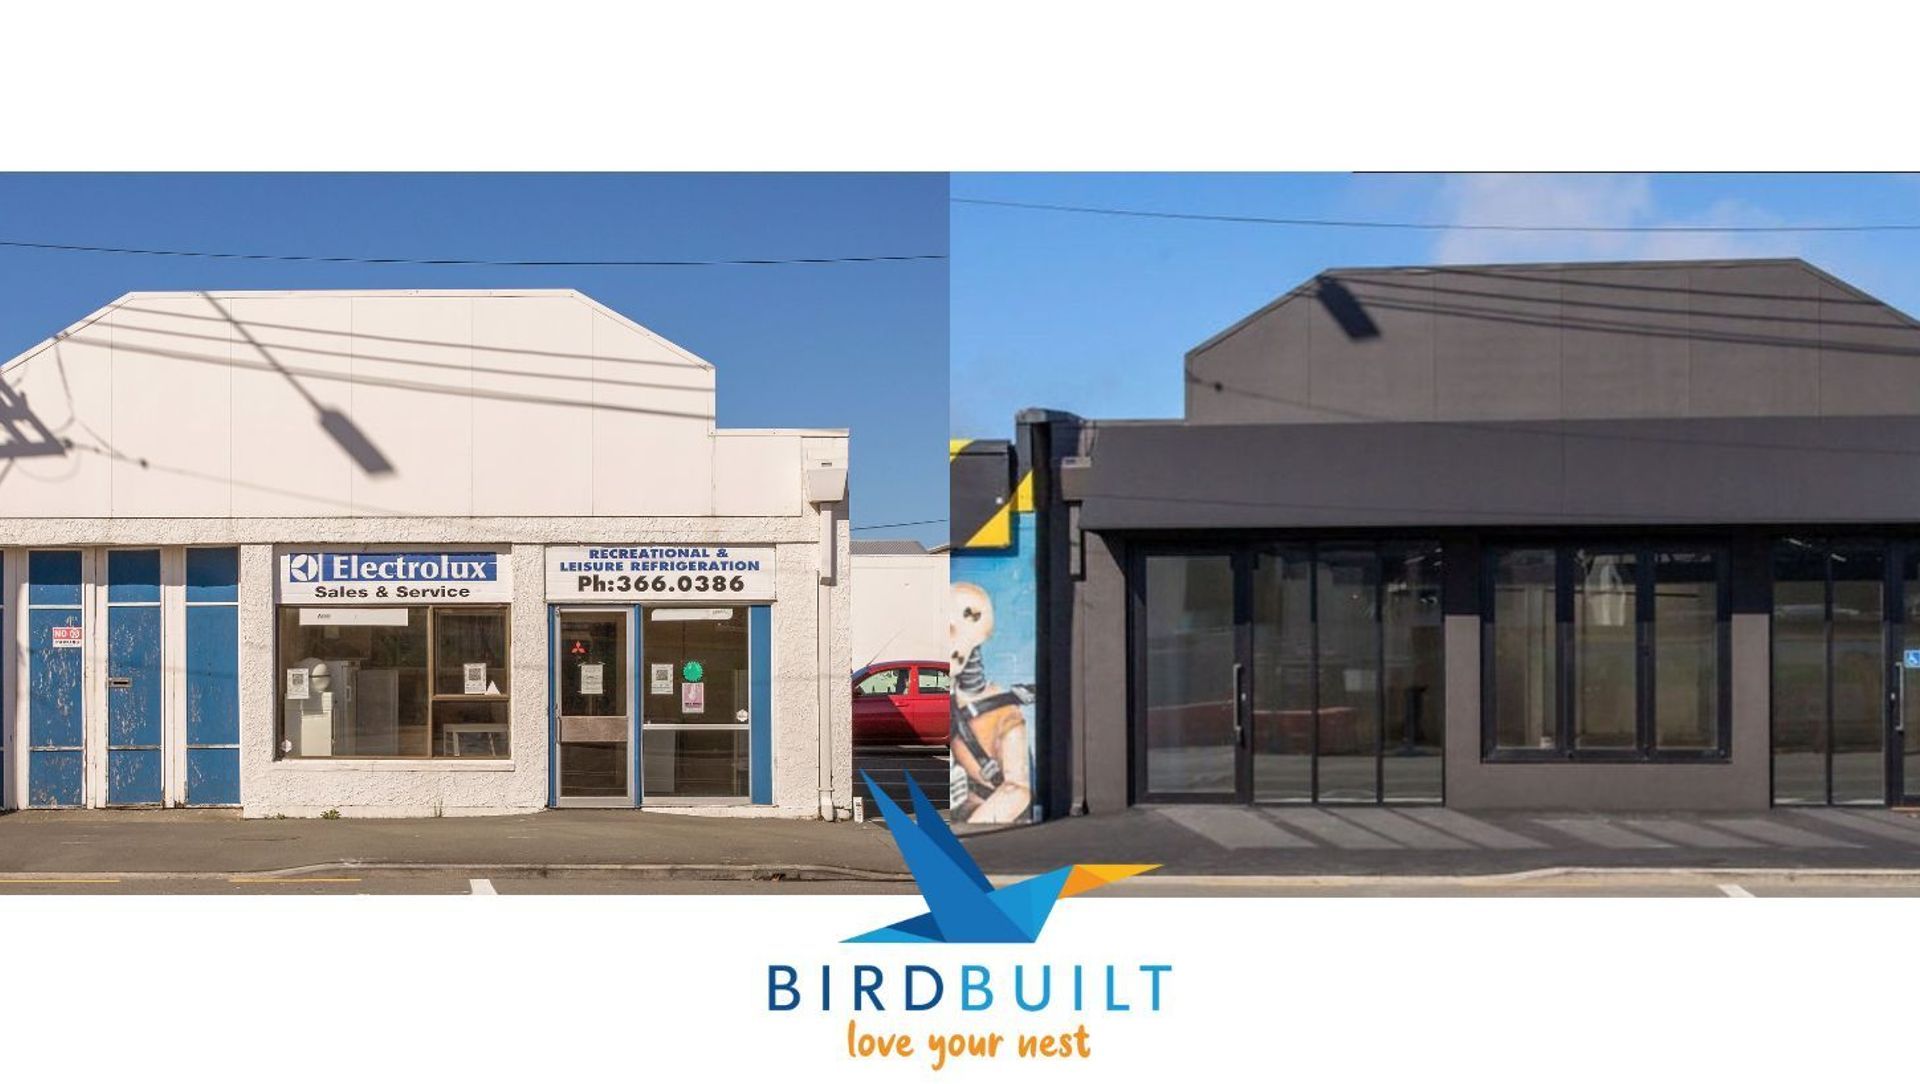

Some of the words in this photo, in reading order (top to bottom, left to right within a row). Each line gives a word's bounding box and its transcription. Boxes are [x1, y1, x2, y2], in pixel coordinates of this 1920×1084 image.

[589, 548, 710, 559] RECREATIONAL
[716, 548, 729, 558] &
[332, 553, 487, 579] Electrolux
[559, 561, 624, 572] LEISURE
[630, 560, 760, 571] REFRIGERATION
[578, 574, 745, 592] Ph:366.0386
[314, 586, 369, 598] Sales
[375, 586, 389, 598] &
[396, 586, 471, 598] Service
